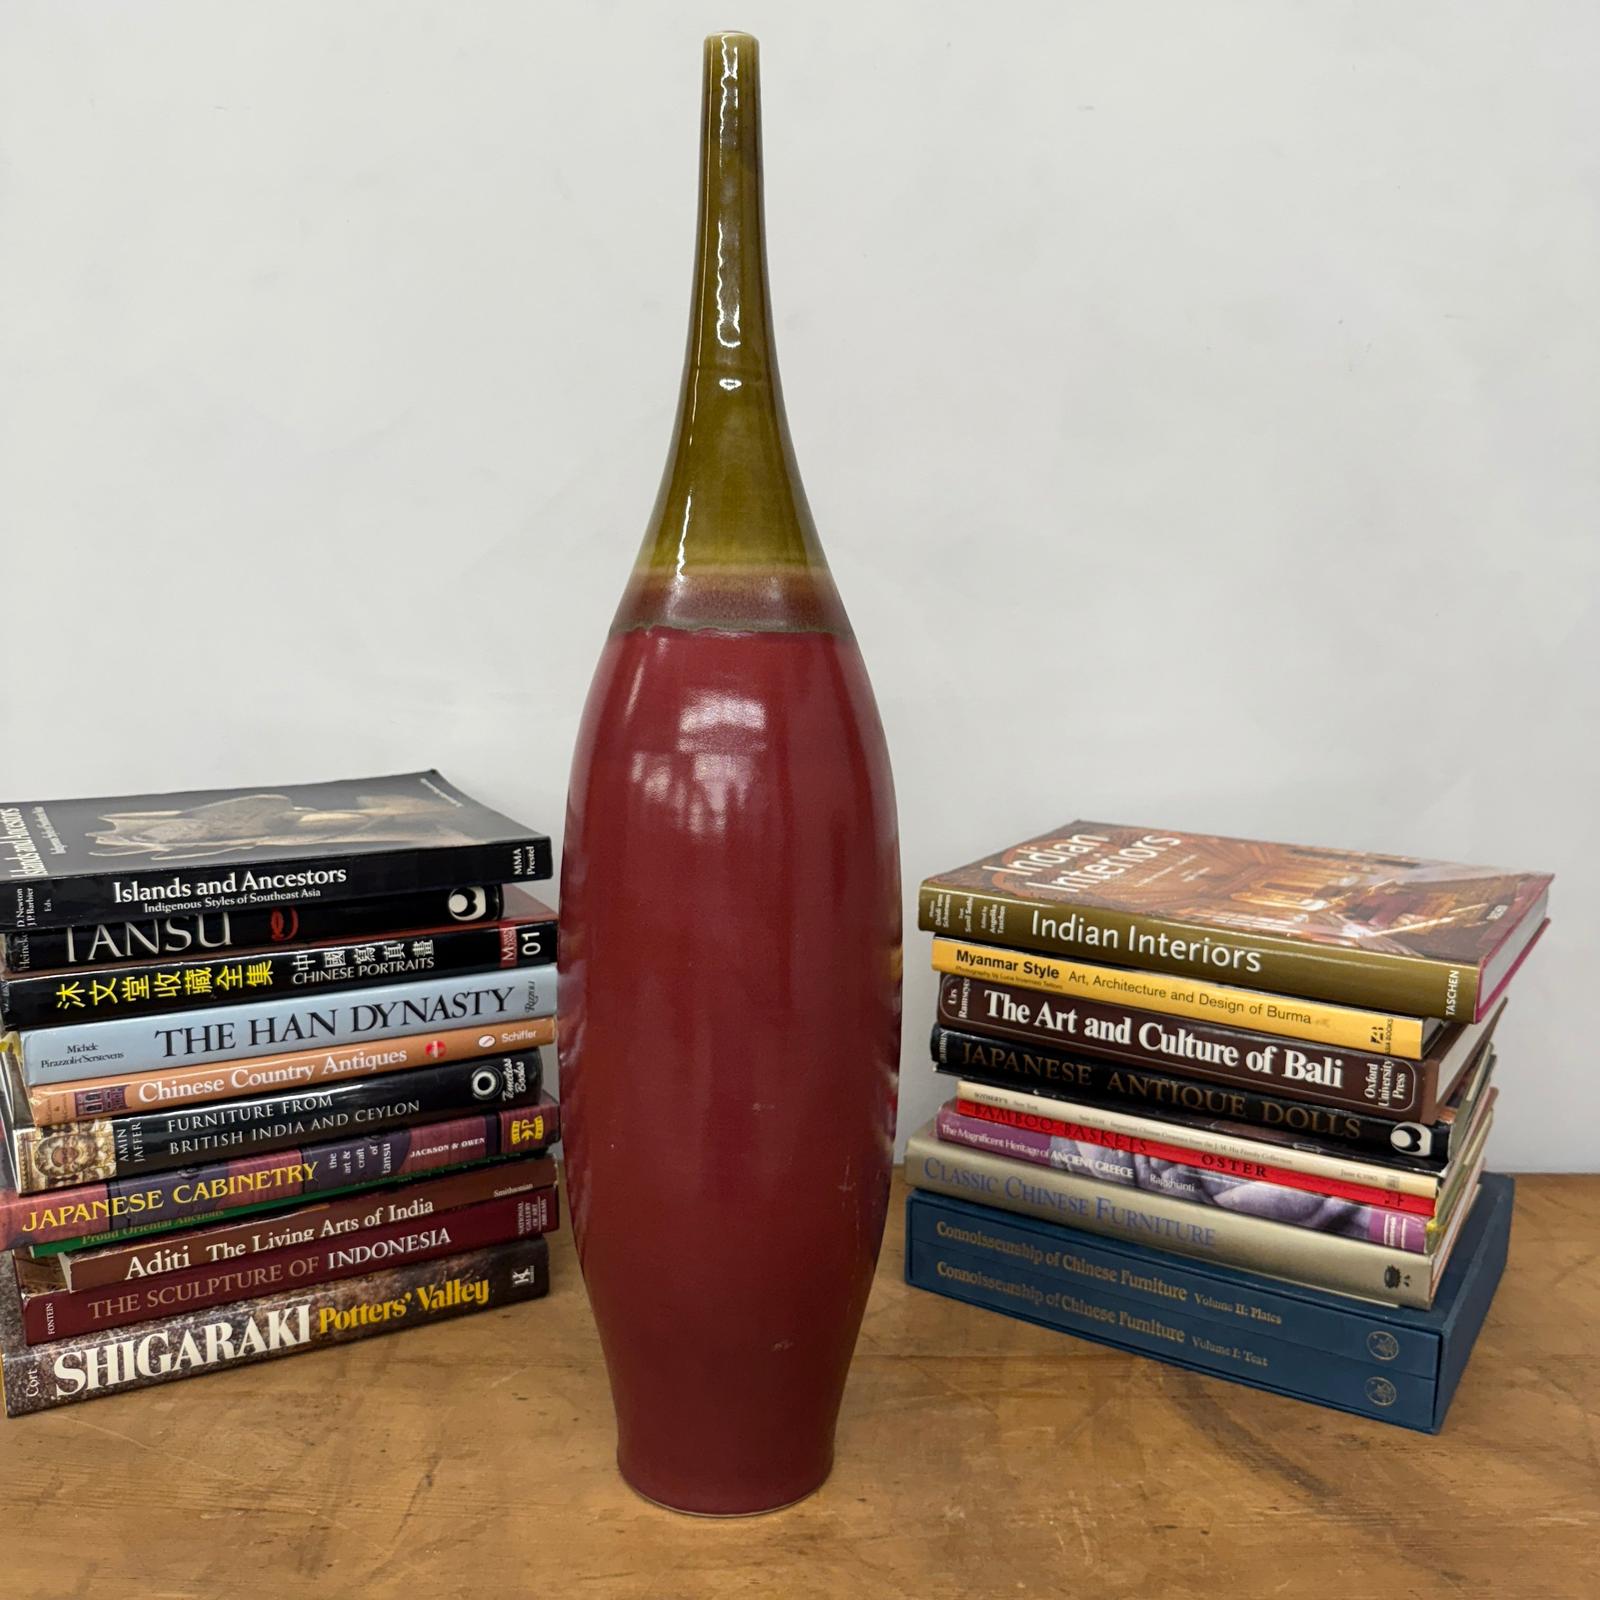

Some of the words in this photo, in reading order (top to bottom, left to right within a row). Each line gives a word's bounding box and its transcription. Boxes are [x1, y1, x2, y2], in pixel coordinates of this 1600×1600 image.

[4, 852, 48, 878] Islands
[512, 848, 522, 875] MMA
[526, 846, 536, 874] Prestel
[982, 834, 1109, 876] Indian
[1025, 835, 1181, 892] Interiors
[16, 888, 24, 917] Newton
[113, 875, 191, 903] Islands
[197, 873, 237, 896] and
[240, 869, 347, 892] Ancestors
[144, 900, 202, 914] Indigenous
[205, 897, 235, 908] Styles
[238, 895, 248, 904] of
[250, 892, 299, 903] Southeast
[301, 888, 321, 898] Asia
[17, 932, 30, 968] Heineke
[67, 911, 232, 962] TANSU
[521, 932, 542, 956] 01
[1032, 910, 1119, 949] Indian
[1128, 926, 1261, 972] Interiors
[56, 960, 274, 1010] 沐文堂收藏全集
[292, 966, 354, 985] CHINESE
[358, 957, 434, 976] PORTRAITS
[956, 950, 1019, 972] Myanmar
[1024, 961, 1060, 979] Style
[1068, 971, 1089, 986] Art,
[1092, 976, 1167, 998] Architecture
[1170, 990, 1194, 1004] and
[1200, 994, 1244, 1014] Design
[1249, 1000, 1264, 1015] of
[1267, 1005, 1312, 1024] Burma
[948, 988, 958, 1004] Urs
[958, 978, 971, 1018] Ramseyer
[1446, 970, 1460, 1016] TASCHEN
[154, 1022, 237, 1058] THE
[248, 1009, 339, 1047] HAN
[351, 986, 516, 1032] DYNASTY
[502, 1029, 537, 1042] Schiffer
[984, 990, 1030, 1024] The
[1034, 1001, 1078, 1034] Art
[1084, 1017, 1132, 1044] and
[1138, 1022, 1239, 1067] Culture
[1246, 1046, 1277, 1074] of
[1282, 1049, 1344, 1089] Bali
[138, 1076, 224, 1103] Chinese
[231, 1062, 314, 1088] Country
[322, 1049, 407, 1075] Antiques
[515, 1061, 526, 1094] Books
[962, 1042, 1093, 1086] JAPANESE
[1107, 1070, 1248, 1118] ANTIQUE
[1262, 1101, 1362, 1140] DOLLS
[1365, 1062, 1378, 1099] Oxford
[1378, 1059, 1395, 1107] University
[1392, 1073, 1406, 1100] Press
[167, 1105, 274, 1133] FURNITURE
[282, 1094, 334, 1116] FROM
[169, 1131, 244, 1156] BRITISH
[252, 1121, 305, 1141] INDIA
[311, 1114, 349, 1131] AND
[355, 1100, 420, 1122] CEYLON
[972, 1102, 1052, 1131] BAMBOO
[1064, 1121, 1148, 1153] BASKETS
[118, 1128, 129, 1162] AMIN
[130, 1122, 144, 1162] JAFFER
[329, 1152, 337, 1169] the
[370, 1144, 378, 1155] of
[382, 1143, 391, 1174] tansu
[410, 1144, 450, 1158] JACKSON
[451, 1142, 460, 1150] &
[461, 1137, 486, 1148] OWEN
[942, 1124, 956, 1136] The
[958, 1128, 1004, 1148] Magnificent
[1005, 1139, 1039, 1158] Heritage
[1040, 1148, 1050, 1158] of
[1050, 1151, 1093, 1170] ANCIENT
[1094, 1160, 1134, 1179] GREECE
[22, 1190, 164, 1232] JAPANESE
[172, 1162, 319, 1202] CABINETRY
[924, 1157, 998, 1194] CLASSIC
[1005, 1176, 1089, 1217] CHINESE
[1096, 1196, 1216, 1246] FURNITURE
[82, 1229, 119, 1244] Proud
[123, 1219, 172, 1235] Oriental
[125, 1244, 192, 1280] Aditi
[206, 1241, 246, 1264] The
[252, 1224, 315, 1252] Living
[320, 1218, 360, 1238] Arts
[364, 1204, 384, 1228] of
[388, 1198, 434, 1220] India
[88, 1293, 141, 1320] THE
[147, 1265, 283, 1308] SCULPTURE
[289, 1256, 320, 1278] OF
[327, 1227, 452, 1270] INDONESIA
[936, 1220, 1043, 1265] Connoisseurship
[1046, 1251, 1060, 1267] of
[1062, 1254, 1119, 1282] Chinese
[1120, 1269, 1188, 1301] Furniture
[1194, 1293, 1233, 1313] Volume
[1235, 1302, 1249, 1316] II:
[1250, 1307, 1282, 1325] Plates
[47, 1302, 56, 1336] FONTEIN
[937, 1261, 1043, 1307] Connoisseurship
[1046, 1292, 1060, 1308] of
[1062, 1295, 1116, 1324] Chinese
[1119, 1311, 1186, 1344] Furniture
[1192, 1336, 1231, 1358] Volume
[1242, 1350, 1269, 1368] Text
[53, 1304, 312, 1396] SHIGARAKI
[319, 1292, 412, 1334] Potters'
[416, 1279, 489, 1312] Valley
[26, 1368, 41, 1397] Cort
